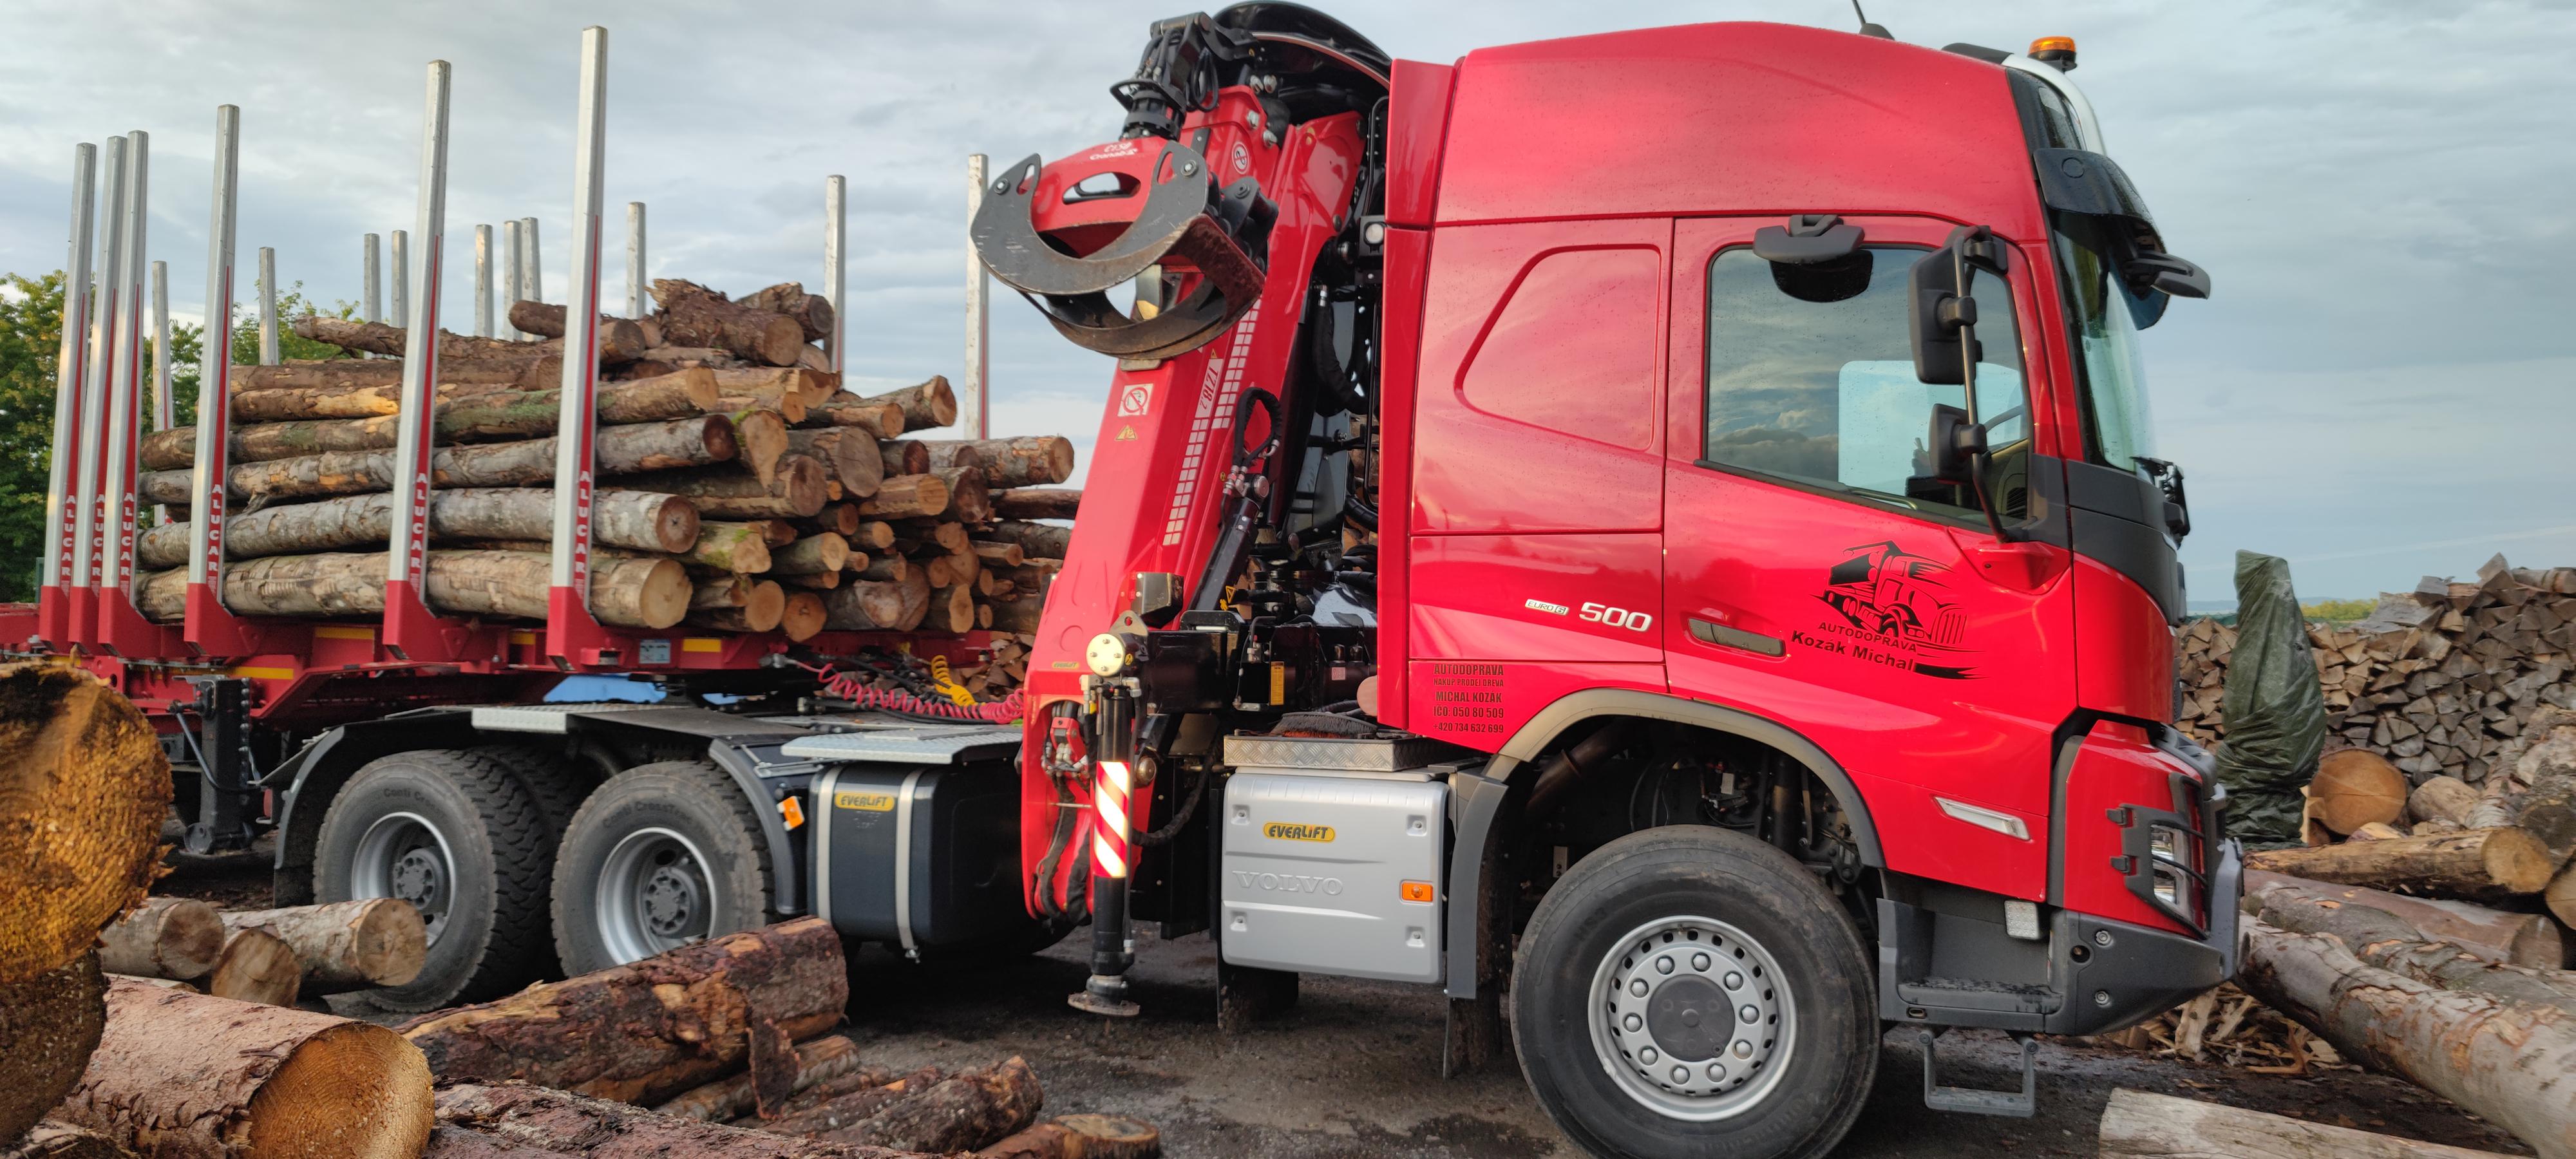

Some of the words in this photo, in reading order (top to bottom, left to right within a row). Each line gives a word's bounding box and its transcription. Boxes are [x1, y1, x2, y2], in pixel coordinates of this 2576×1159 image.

[61, 495, 76, 576] ALUCAR
[91, 494, 105, 576] ALUCAR
[118, 493, 134, 576] ALUCAR
[207, 484, 222, 571] ALUCAR
[410, 473, 428, 568] ALUCAR
[575, 471, 591, 573] ALUCAR
[1528, 601, 1554, 611] EURO
[1579, 602, 1652, 632] 500
[1791, 630, 1846, 655] Kozák
[1852, 645, 1914, 672] Michal
[1818, 622, 1917, 652] AUTODOPRAVA
[1434, 664, 1504, 675] AUTODOPRAVA
[1434, 704, 1451, 717] IČO:
[1453, 706, 1470, 717] 050
[1472, 707, 1484, 718] 80
[1486, 708, 1504, 719] 509
[1436, 691, 1470, 702] MICHAL
[1472, 690, 1502, 703] KOZÁK
[1433, 722, 1453, 731] +420
[1455, 722, 1468, 732] 734
[1470, 723, 1486, 733] 632
[1488, 724, 1504, 733] 699
[1232, 871, 1343, 896] VOLVO
